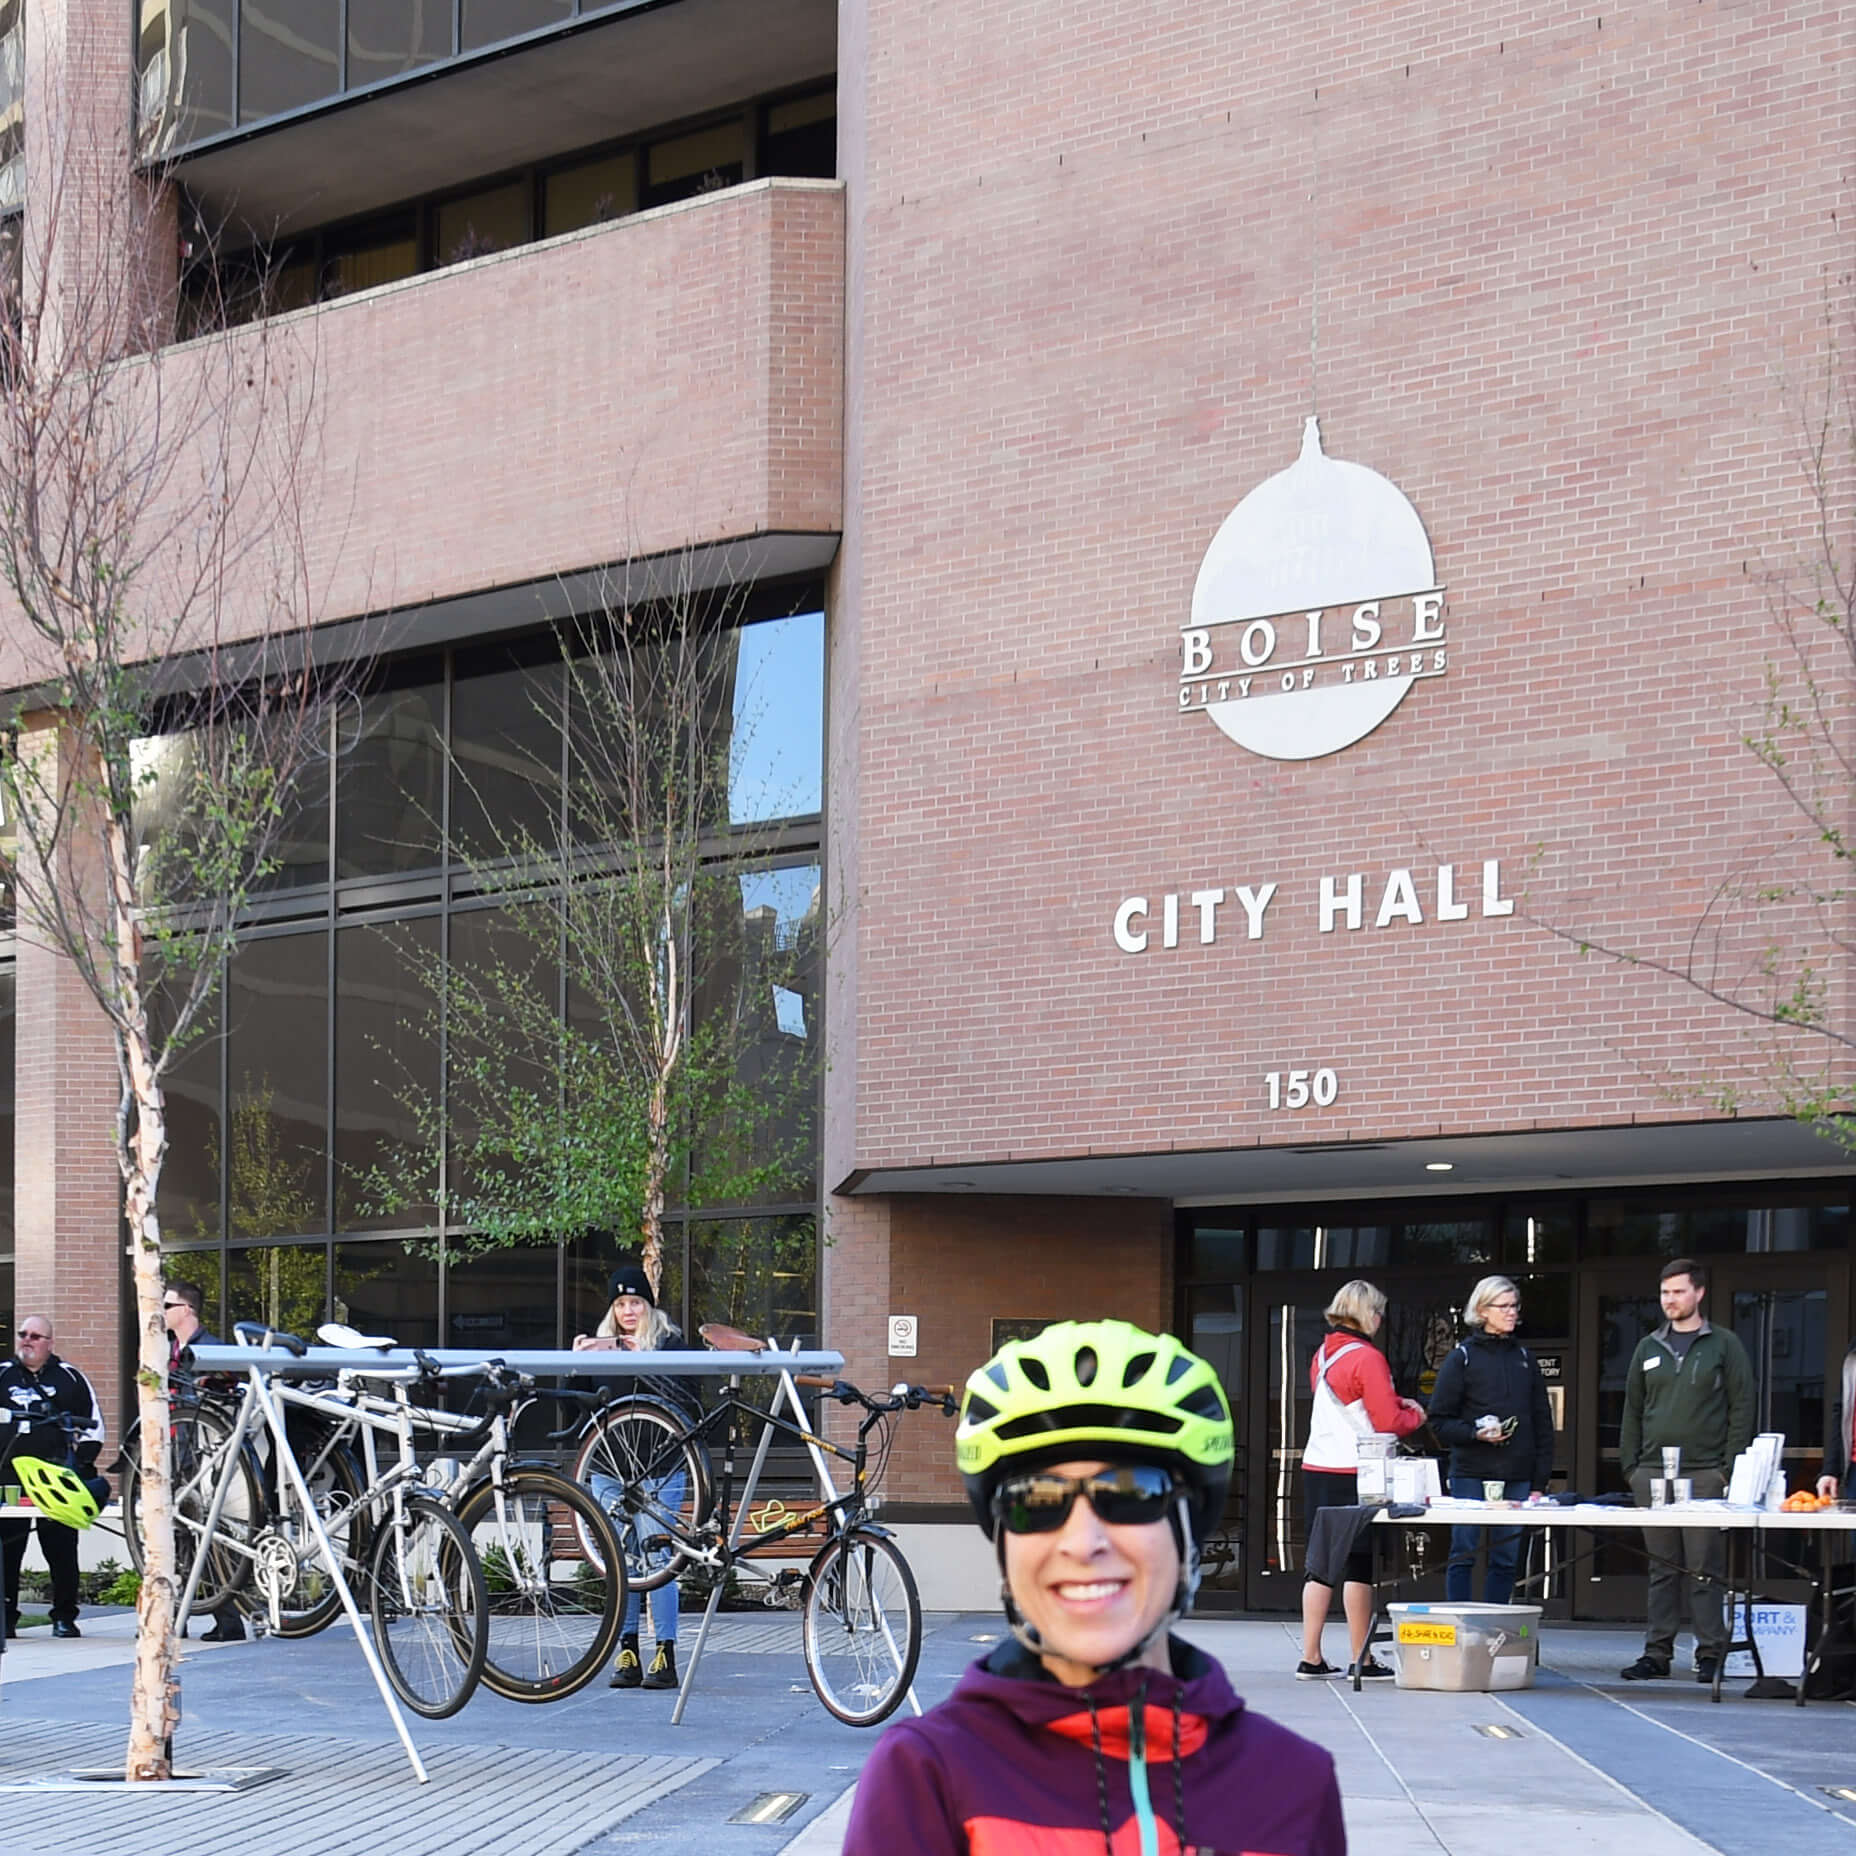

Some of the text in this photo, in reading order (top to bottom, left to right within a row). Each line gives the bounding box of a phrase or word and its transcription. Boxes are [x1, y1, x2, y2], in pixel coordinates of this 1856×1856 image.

[1181, 592, 1445, 677] BOISE
[1178, 650, 1447, 706] CITY OF TREES
[1112, 859, 1516, 955] CITY HALL
[1263, 1067, 1340, 1111] 150
